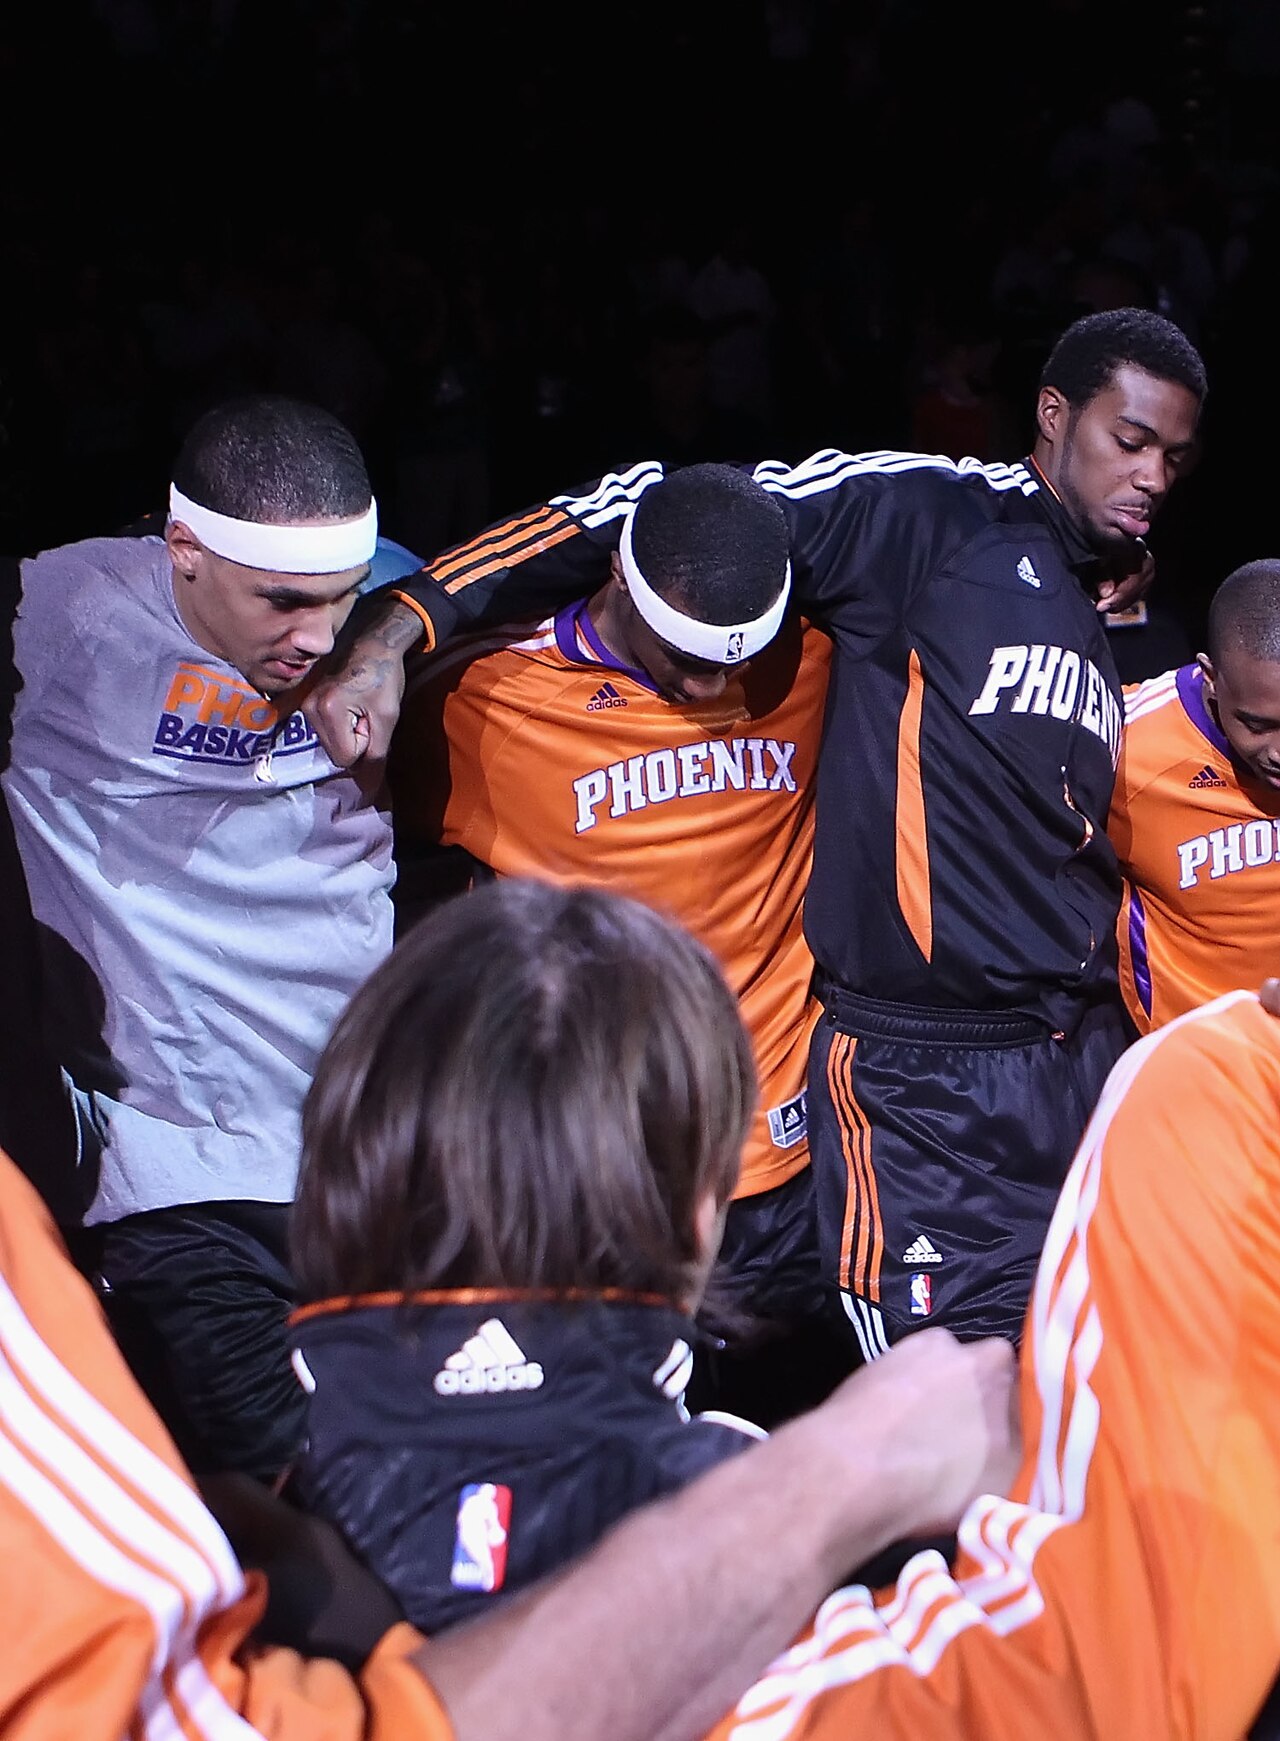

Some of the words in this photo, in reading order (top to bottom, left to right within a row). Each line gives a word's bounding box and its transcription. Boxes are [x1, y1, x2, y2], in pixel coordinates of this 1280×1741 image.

[586, 697, 628, 712] adidas
[572, 737, 798, 834] PHOENIX
[1188, 779, 1227, 789] adidas
[433, 1361, 545, 1396] adidas
